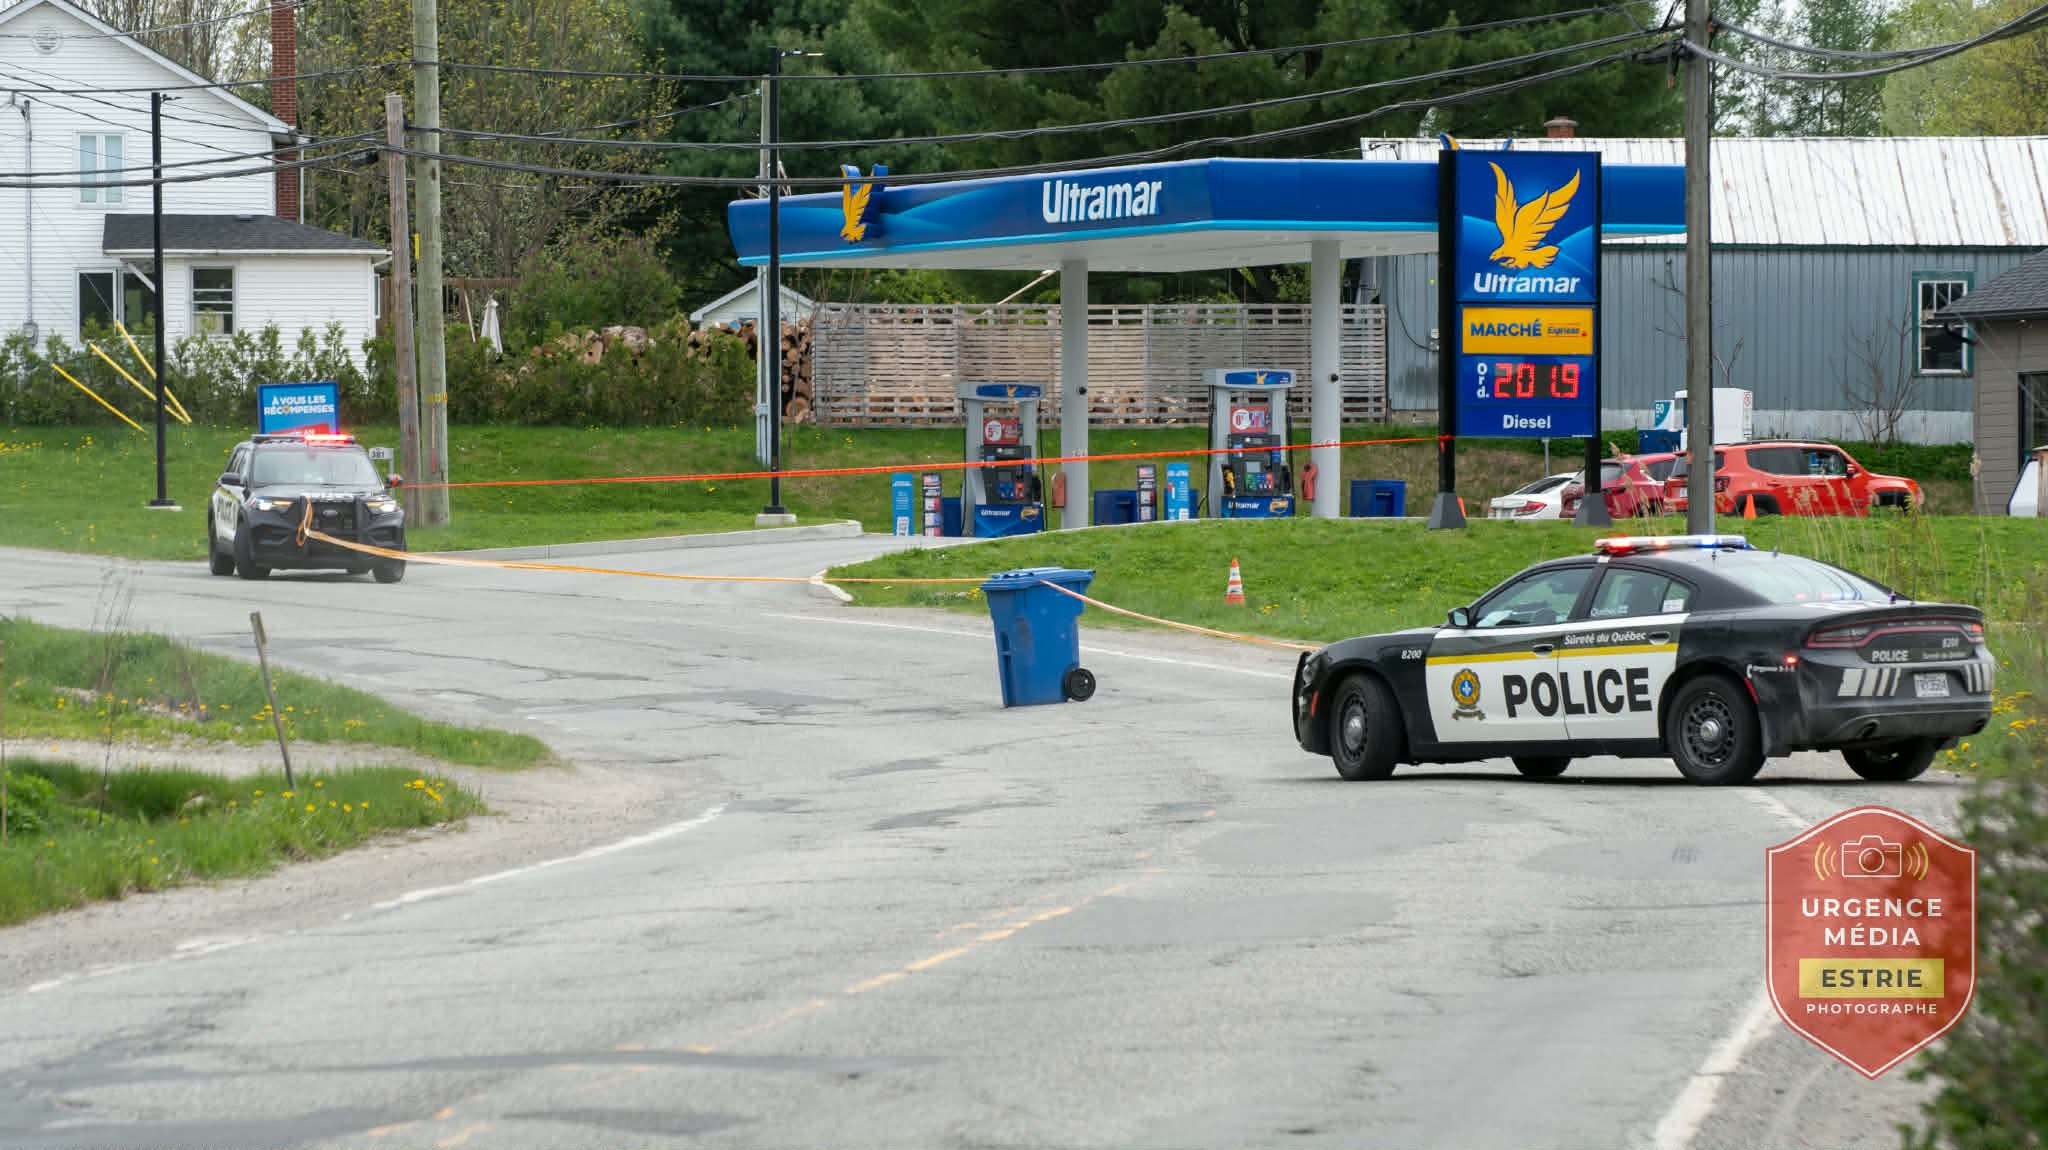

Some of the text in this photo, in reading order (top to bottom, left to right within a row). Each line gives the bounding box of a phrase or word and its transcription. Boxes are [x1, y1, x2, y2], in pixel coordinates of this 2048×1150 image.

[1042, 180, 1163, 224] Ultramar
[1473, 272, 1581, 294] Ultramar
[1470, 318, 1542, 337] MARCHÉ
[280, 396, 306, 405] VOUS
[308, 395, 326, 404] LES
[1502, 414, 1552, 430] Diesel
[1564, 630, 1647, 646] Sûreté du Québec
[1401, 649, 1422, 660] 8200
[1871, 649, 1910, 663] POLICE
[1502, 666, 1653, 719] POLICE
